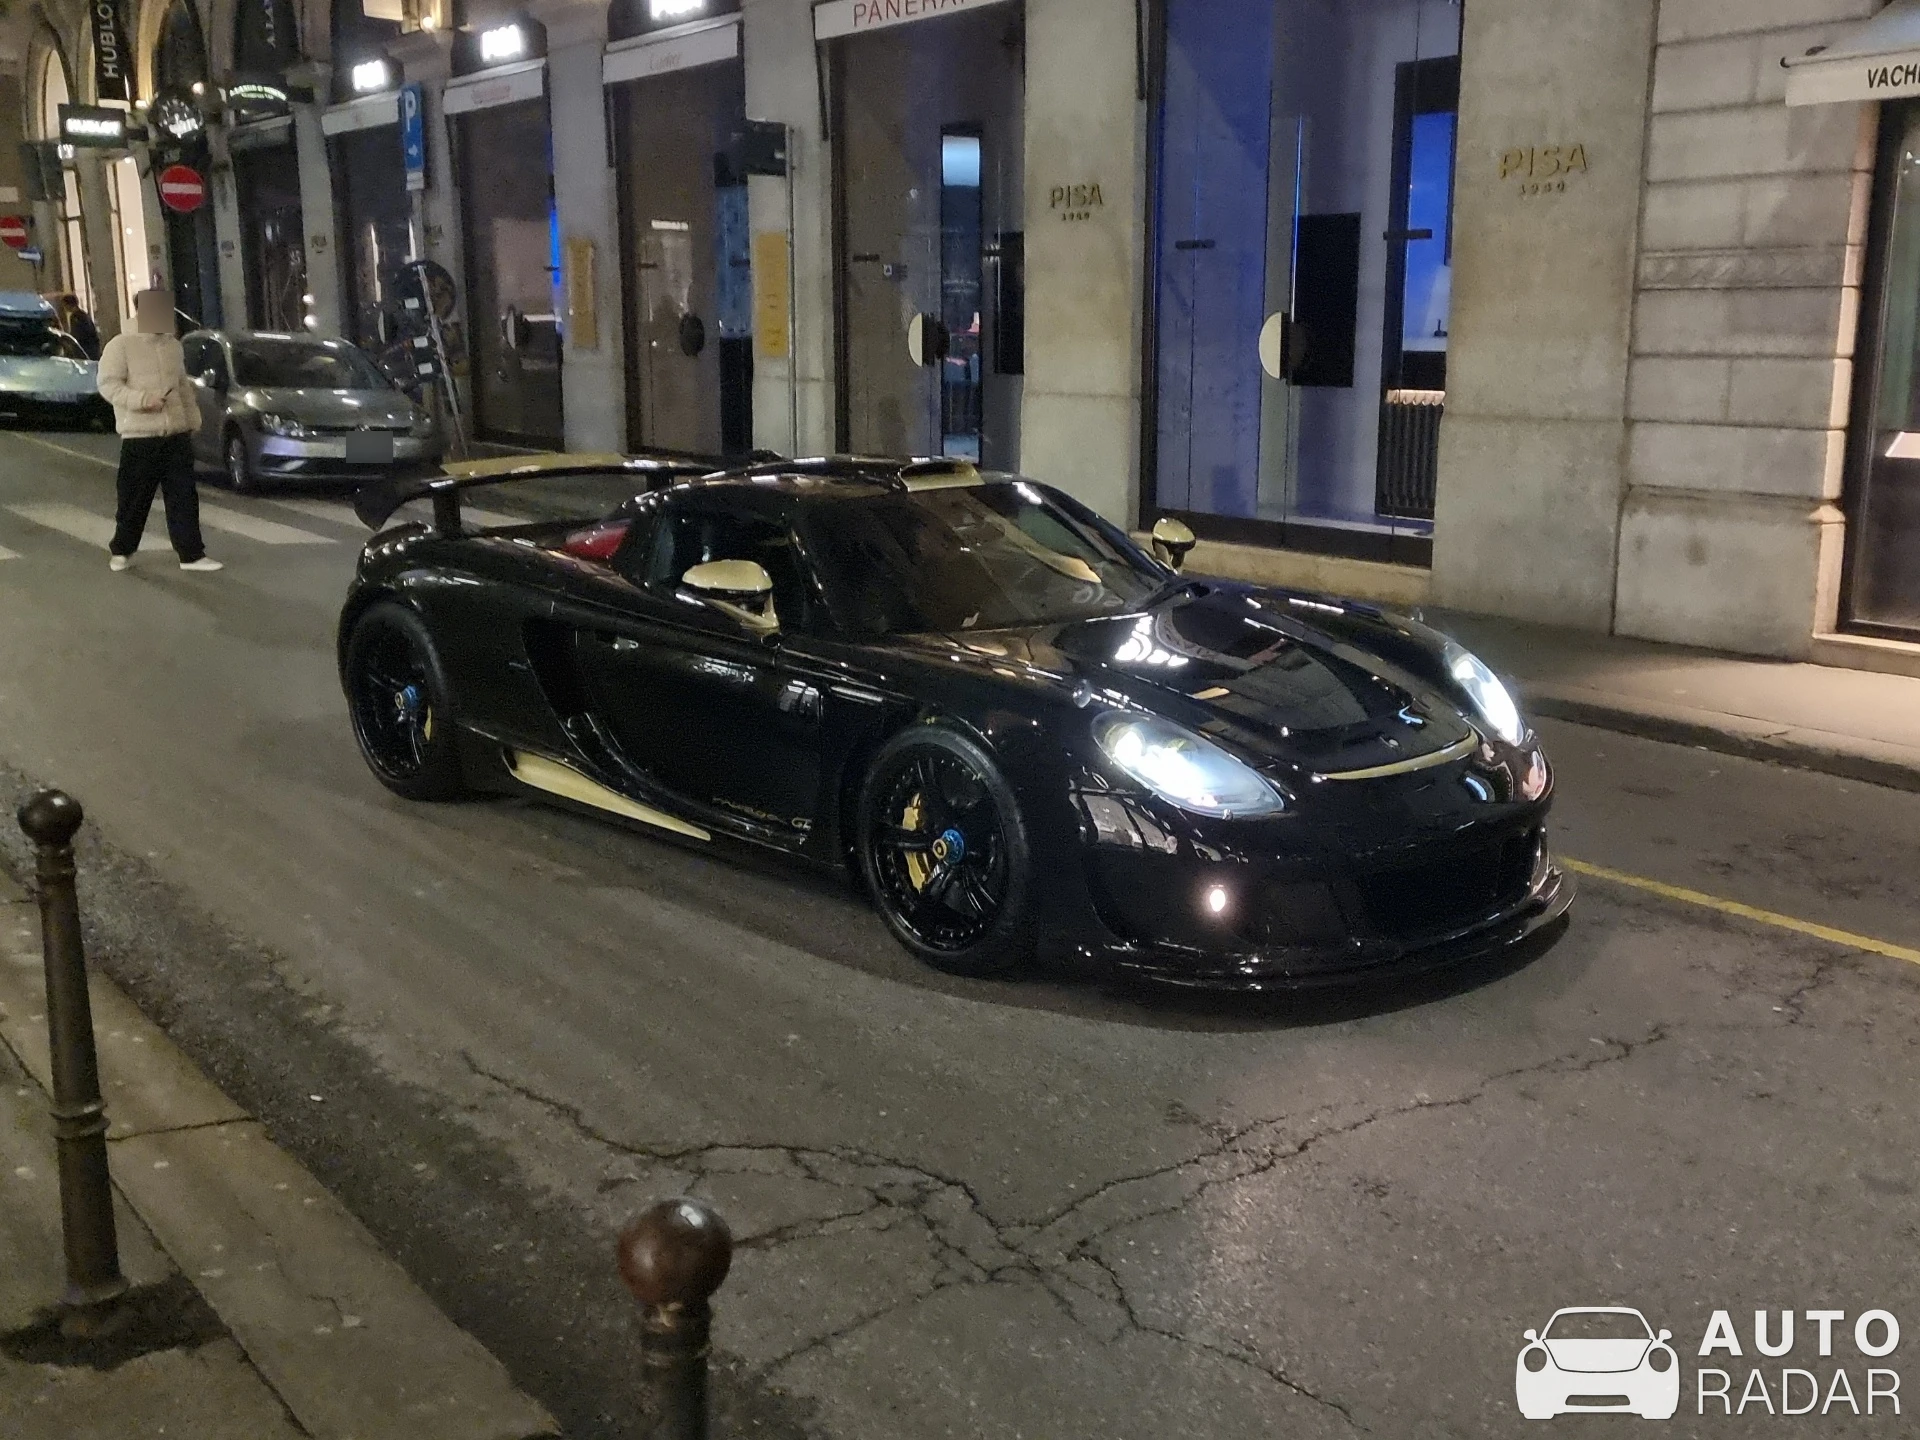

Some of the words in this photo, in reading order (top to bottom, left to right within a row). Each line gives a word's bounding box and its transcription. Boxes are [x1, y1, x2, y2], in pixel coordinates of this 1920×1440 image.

[853, 0, 965, 28] PANER
[96, 0, 119, 78] HUBLO
[1867, 62, 1920, 89] VACH
[405, 90, 417, 132] P
[1500, 143, 1588, 179] PISA
[1051, 183, 1103, 209] PISA
